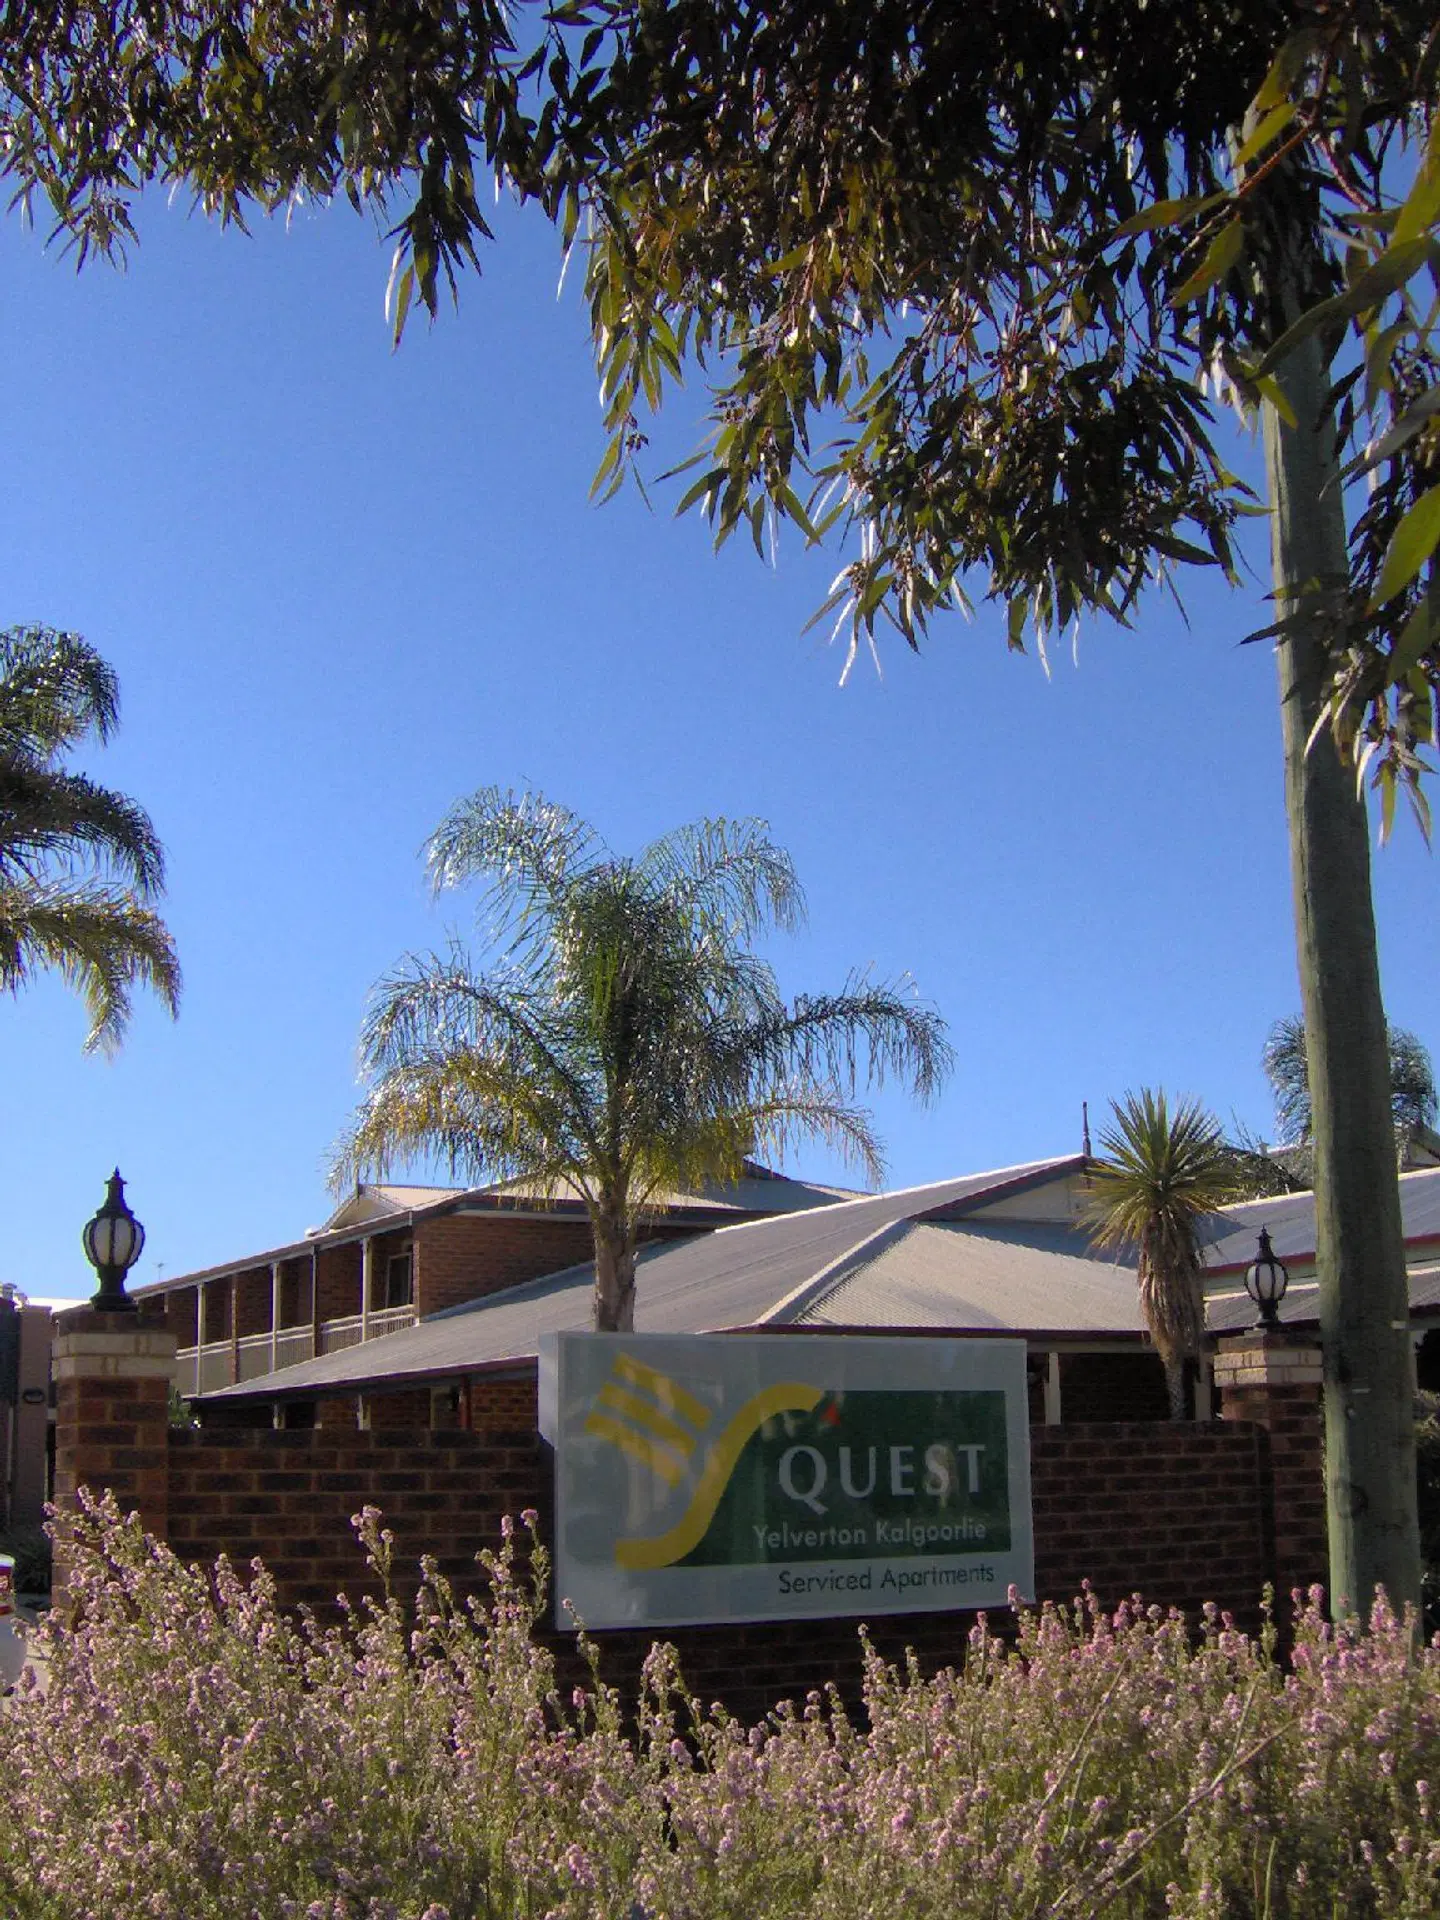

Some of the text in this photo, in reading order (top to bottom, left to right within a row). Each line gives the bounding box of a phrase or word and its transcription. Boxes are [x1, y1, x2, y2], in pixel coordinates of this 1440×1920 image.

[778, 1444, 986, 1515] QUEST
[753, 1517, 986, 1549] Yelverton Kalgoorlie
[779, 1563, 994, 1594] Serviced Apartments
